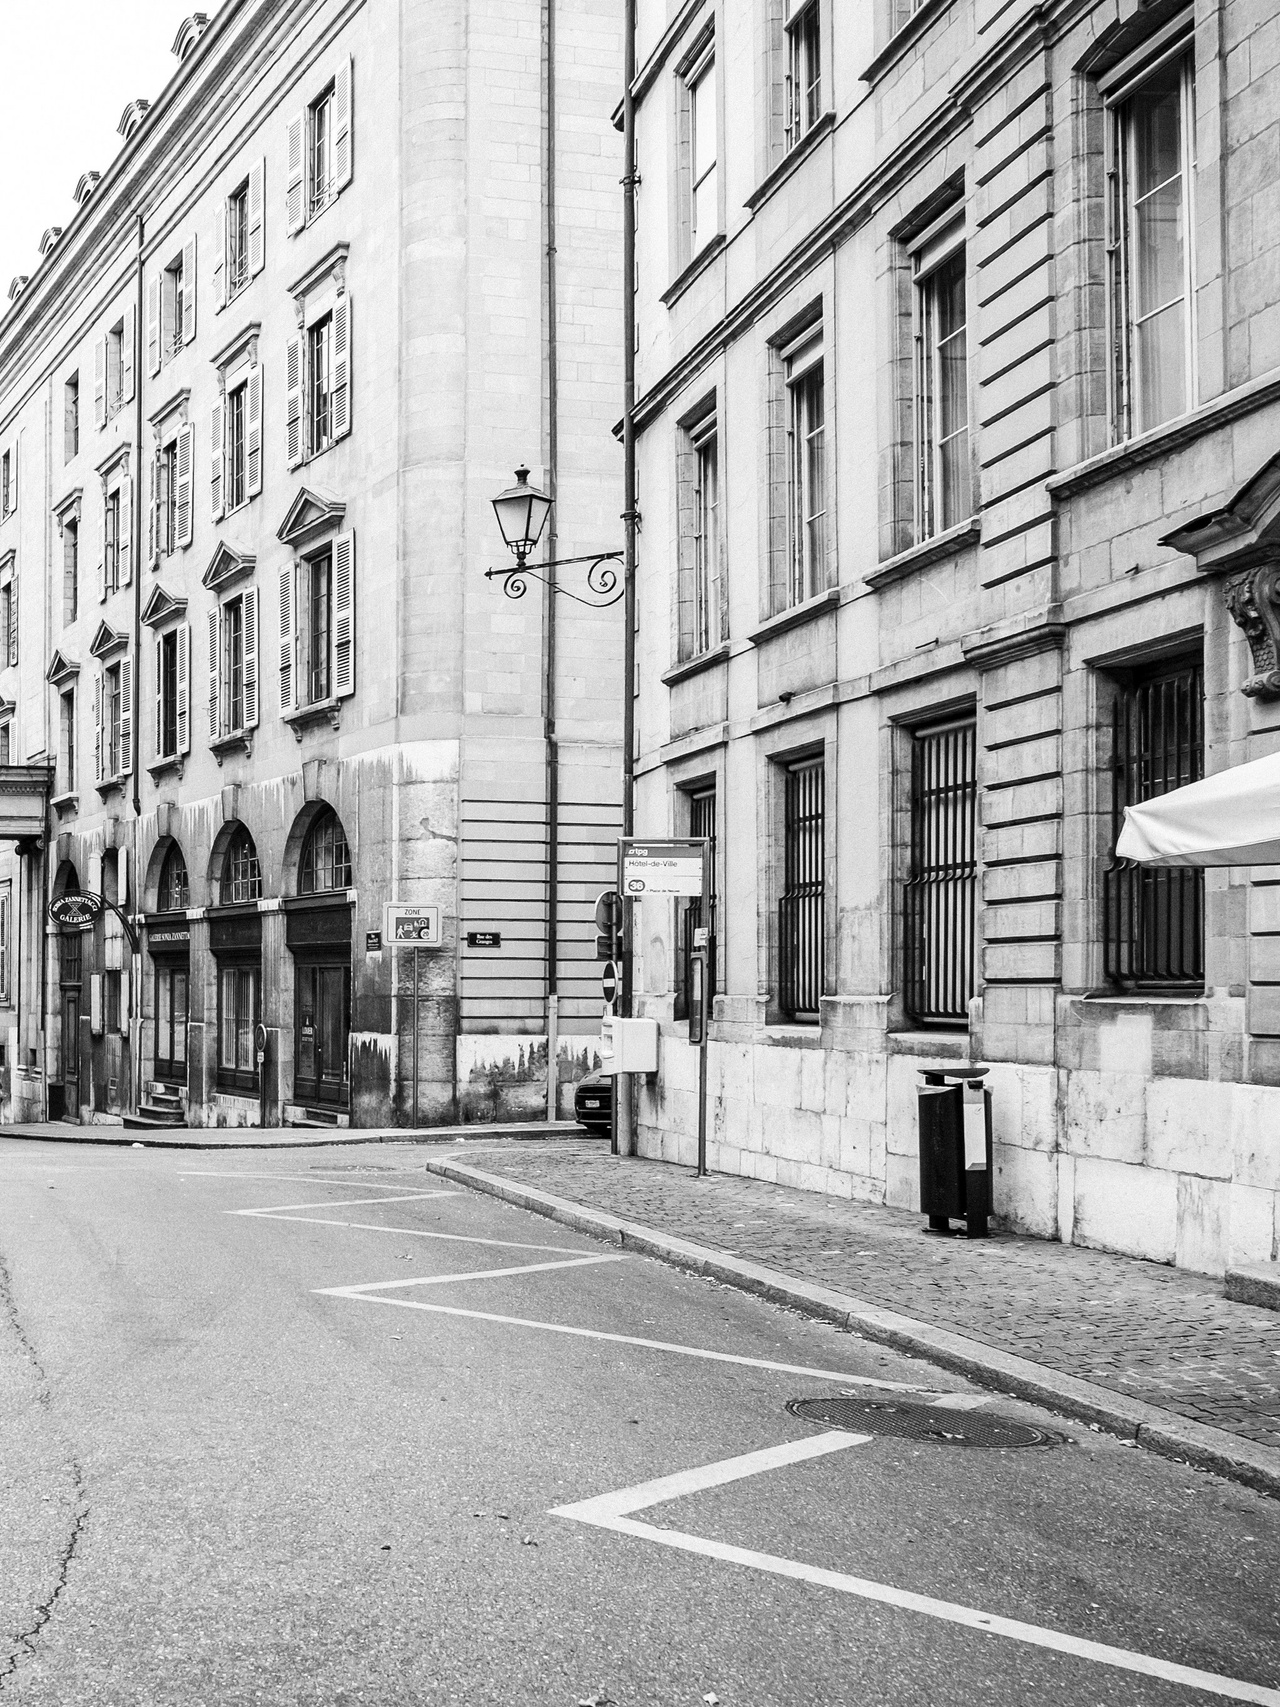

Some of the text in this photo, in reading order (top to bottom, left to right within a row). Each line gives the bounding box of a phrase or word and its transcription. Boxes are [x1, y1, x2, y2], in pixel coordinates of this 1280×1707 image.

[636, 848, 648, 856] tpg
[629, 881, 644, 890] 36
[59, 913, 91, 923] GALERIE
